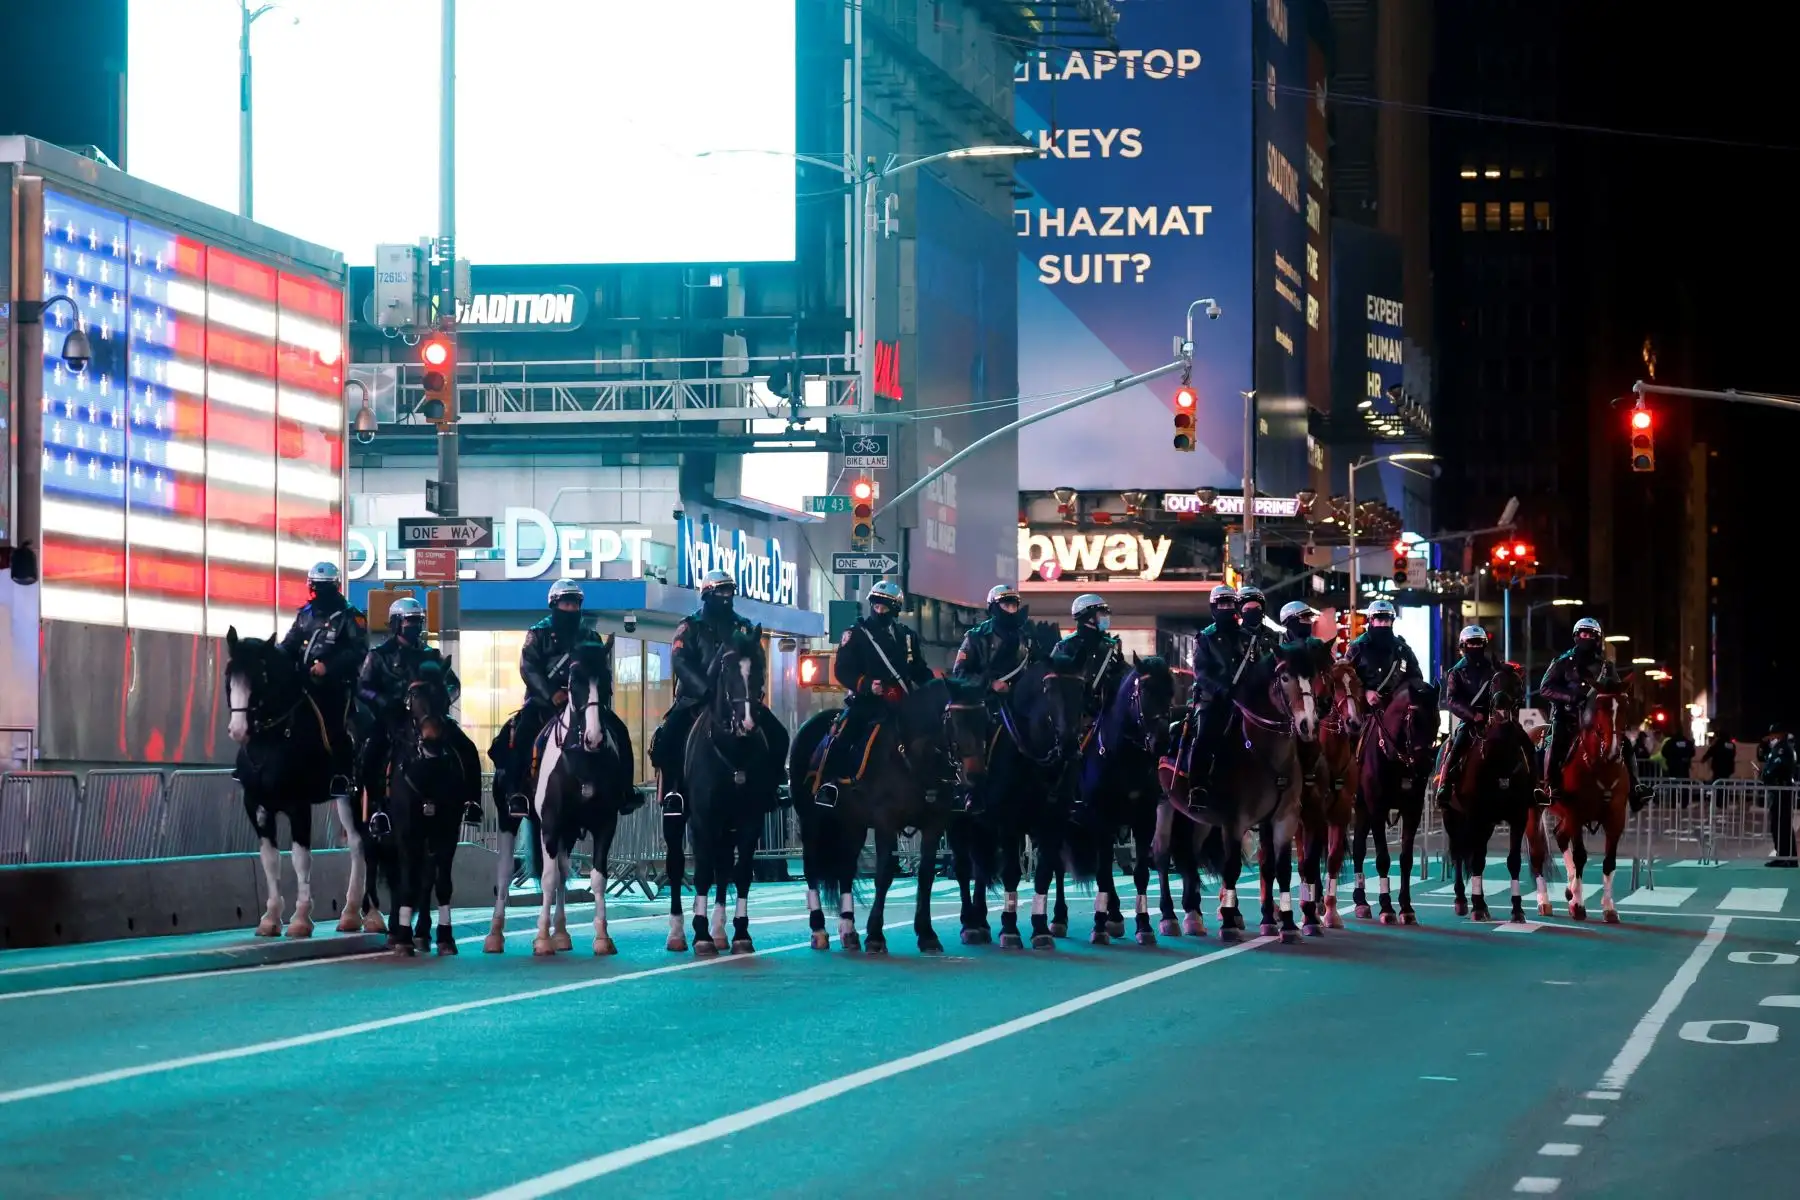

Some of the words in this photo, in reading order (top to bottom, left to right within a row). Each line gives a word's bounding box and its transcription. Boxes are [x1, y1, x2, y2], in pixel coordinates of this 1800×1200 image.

[1038, 49, 1202, 81] LAPTOP
[1039, 127, 1142, 159] KEYS
[1039, 205, 1212, 237] HAZMAT
[1038, 253, 1152, 284] SUIT?
[1367, 294, 1404, 327] EXPERT
[1367, 333, 1402, 365] HUMAN
[1367, 371, 1381, 399] HR
[846, 457, 863, 466] BIKE
[865, 457, 887, 466] LANE
[816, 498, 826, 511] W
[831, 498, 844, 512] 43
[1255, 500, 1295, 514] PRIME
[412, 527, 439, 539] ONE
[451, 527, 478, 539] WAY
[505, 506, 653, 579] DEPT
[838, 558, 858, 568] ONE
[869, 558, 889, 568] WAY
